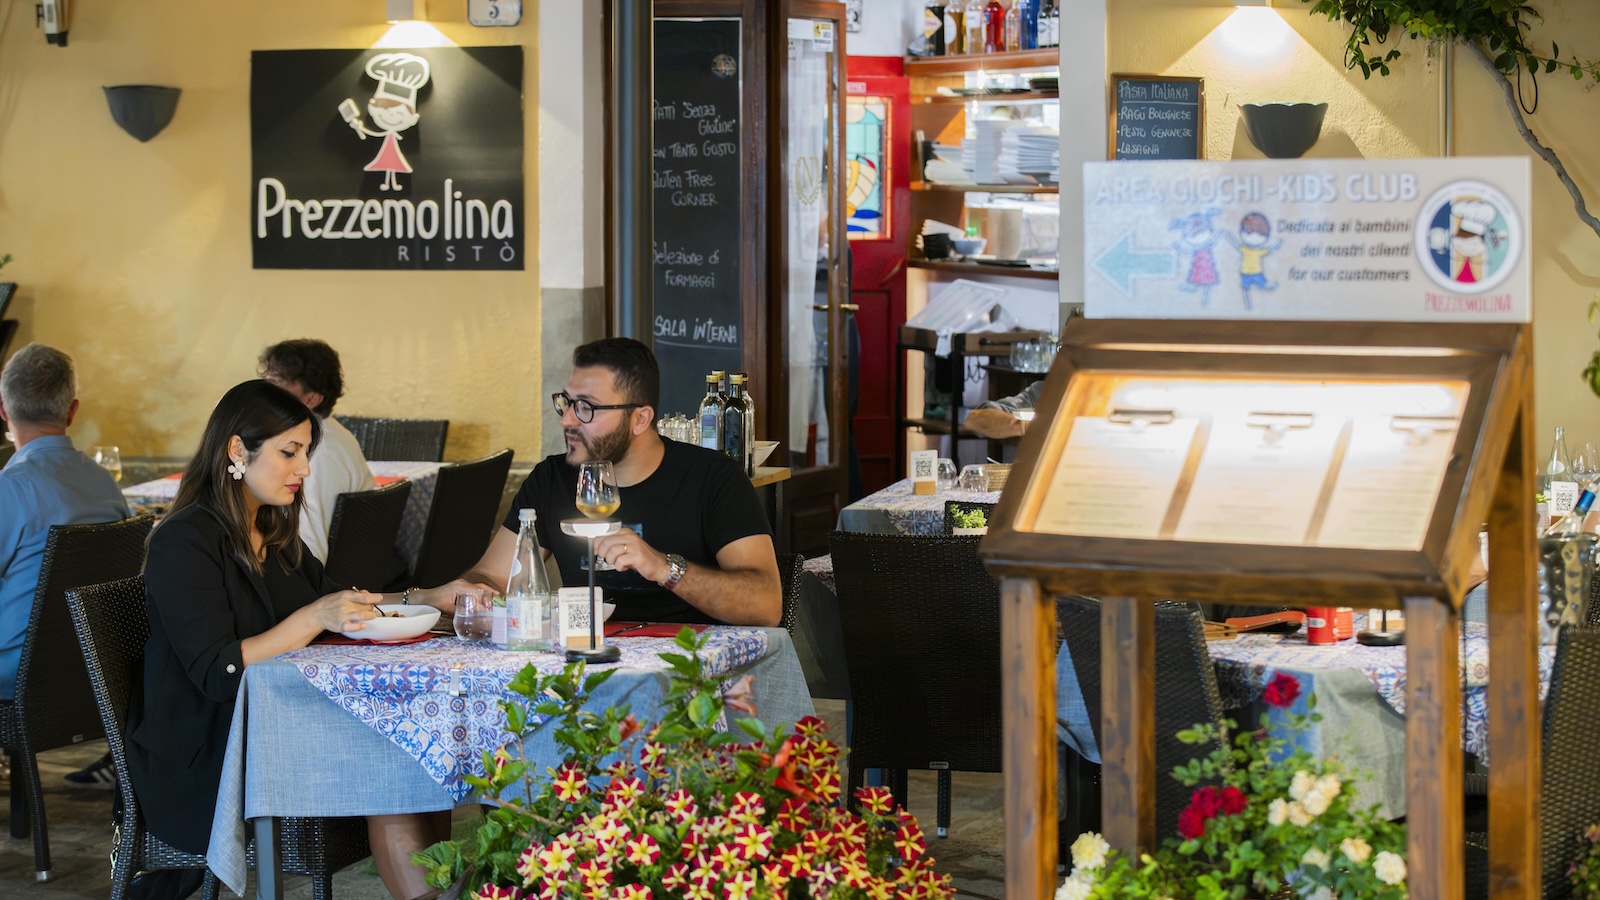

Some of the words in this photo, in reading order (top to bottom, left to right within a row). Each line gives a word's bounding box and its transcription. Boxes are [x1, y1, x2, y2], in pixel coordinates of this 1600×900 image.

[1119, 80, 1147, 99] PASTA
[1149, 107, 1192, 121] BOLOGNESE
[1121, 124, 1146, 137] PESTO
[1151, 125, 1192, 138] GENOVESE
[669, 142, 698, 158] TANTO
[702, 140, 736, 157] GUSTO
[1121, 142, 1160, 155] LASAGNA
[1095, 176, 1162, 205] AREA
[1169, 174, 1262, 205] GIOCHI
[1345, 172, 1420, 203] CLUB
[671, 190, 718, 207] CORNER
[258, 177, 514, 240] Prezzemolina
[1276, 219, 1335, 234] Dedicata
[1339, 219, 1350, 233] ai
[1354, 219, 1411, 233] bambini
[398, 241, 515, 262] RISTÒ
[1300, 243, 1321, 257] dei
[1325, 243, 1366, 257] nostri
[1369, 242, 1411, 257] clienti
[1287, 266, 1307, 281] for
[1310, 269, 1335, 281] our
[1337, 268, 1411, 281] customers
[1425, 292, 1512, 313] PREZZEMOLINA
[654, 315, 687, 337] SALA
